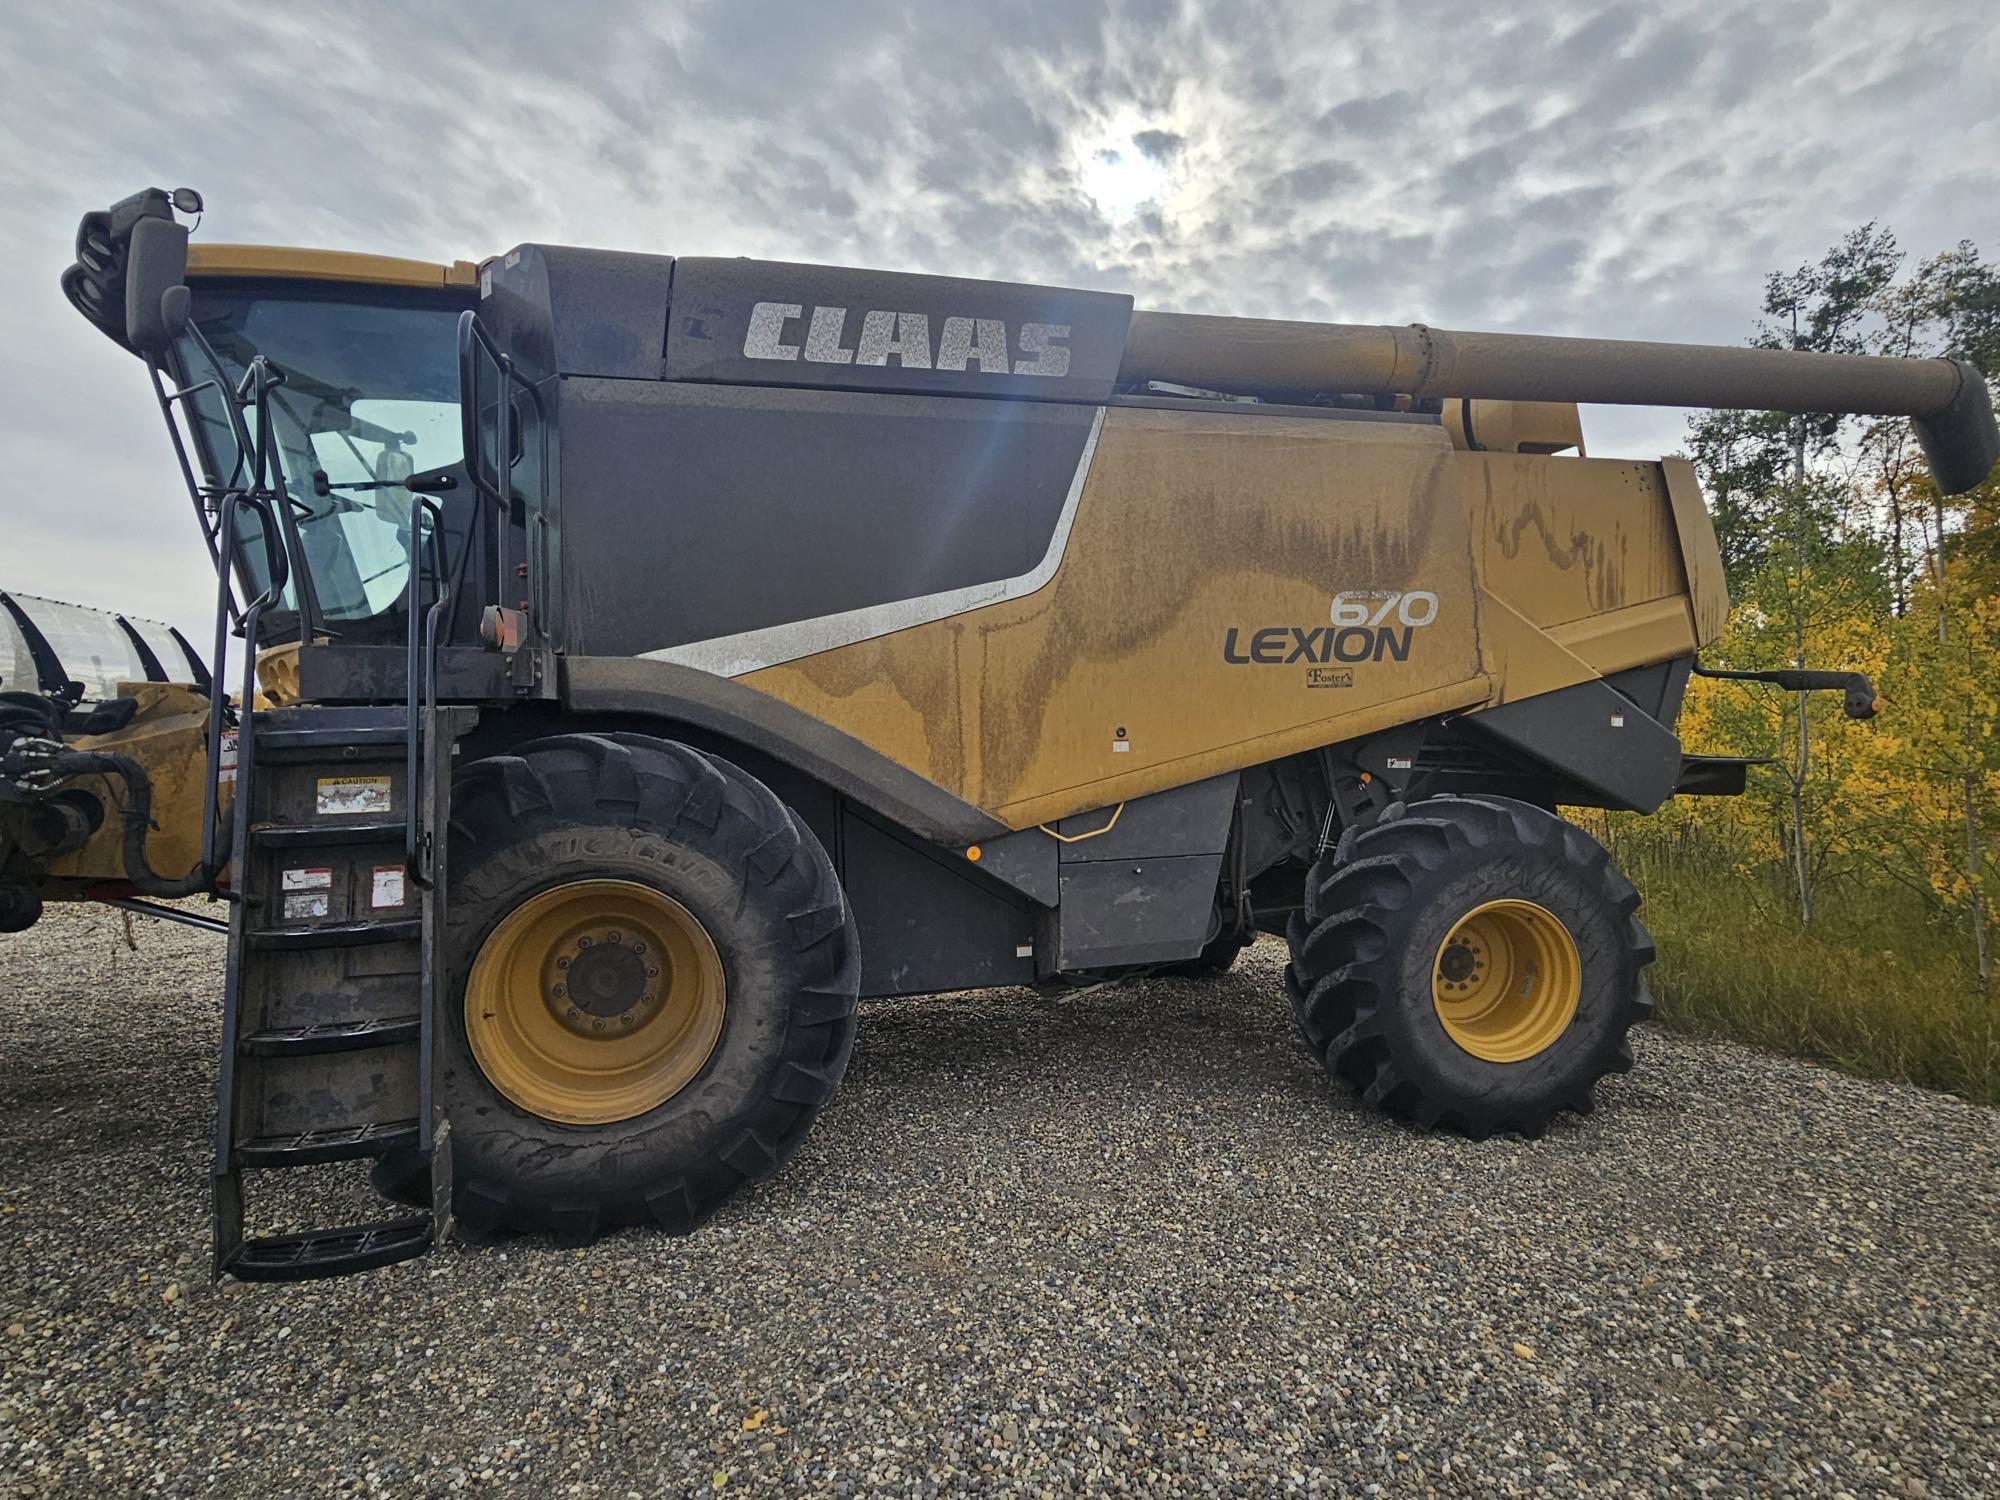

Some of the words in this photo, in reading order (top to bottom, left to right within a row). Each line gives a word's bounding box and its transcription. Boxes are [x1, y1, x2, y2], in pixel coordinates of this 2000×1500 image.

[743, 302, 1072, 377] CLAAS
[1330, 590, 1439, 626] 670
[1224, 627, 1414, 665] LEXION
[341, 777, 378, 785] CAUTION
